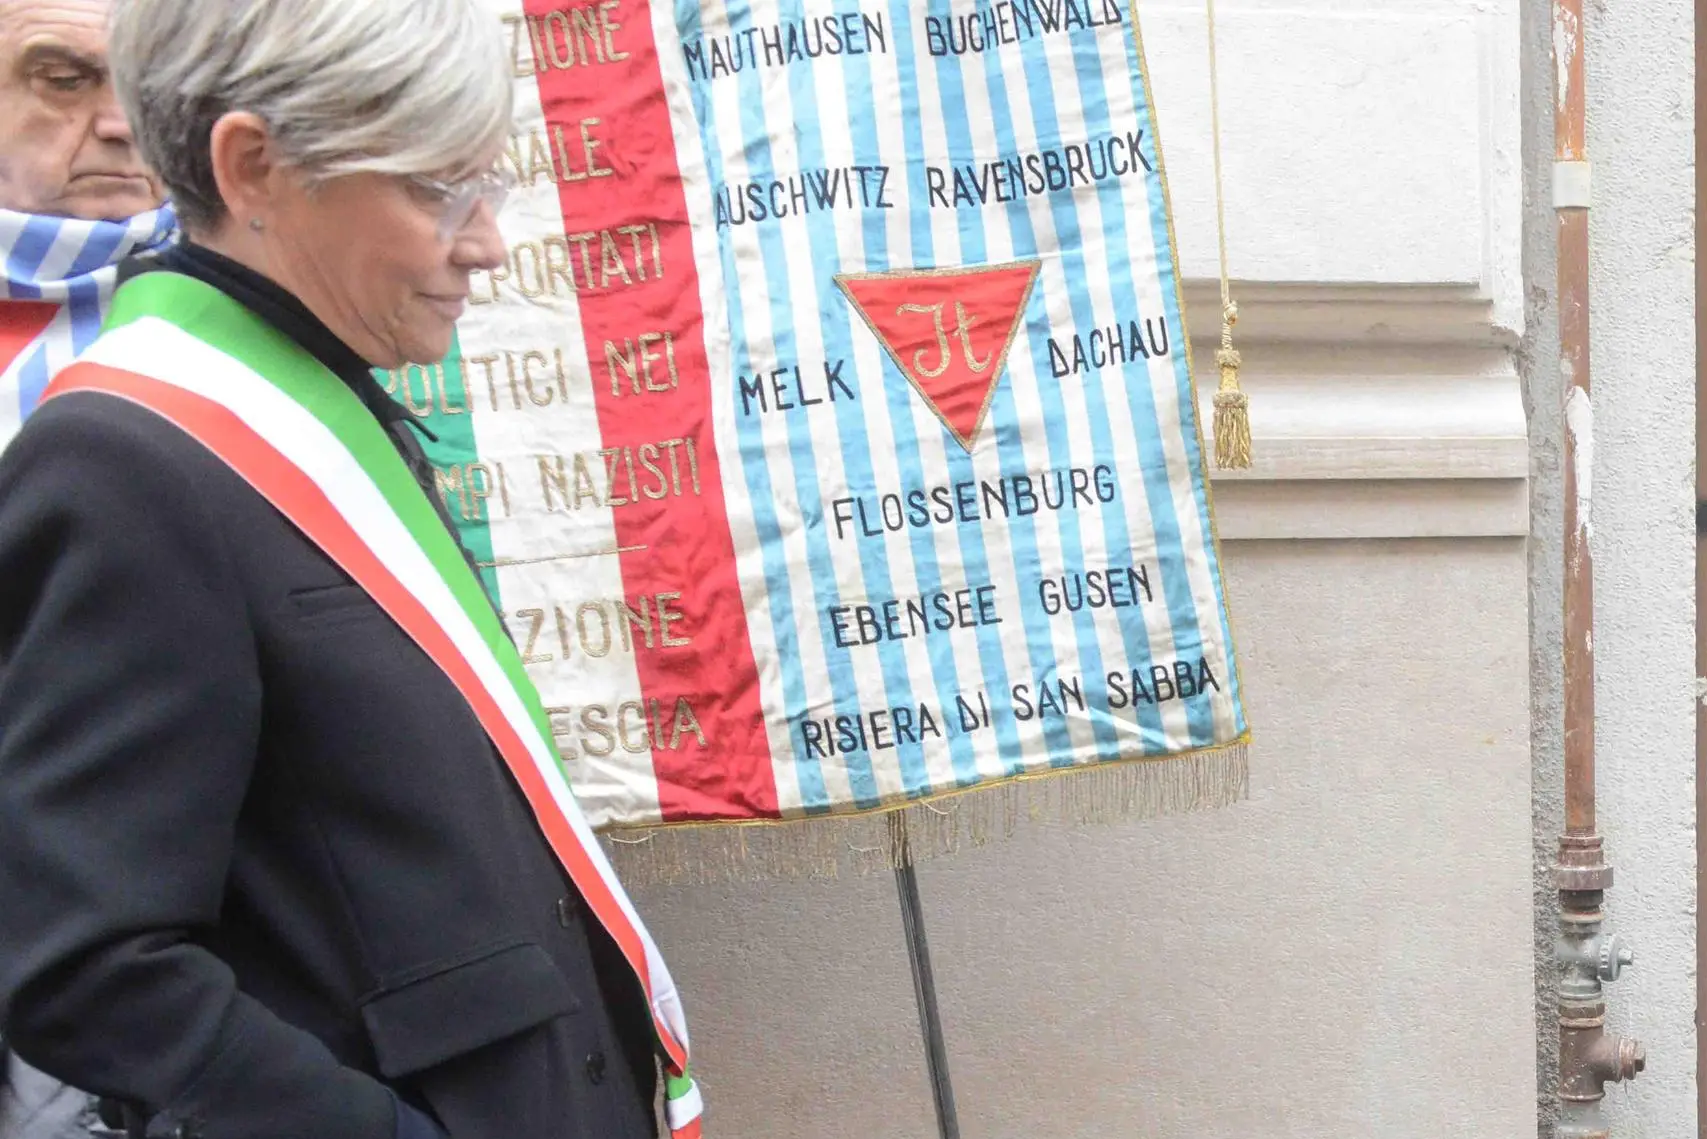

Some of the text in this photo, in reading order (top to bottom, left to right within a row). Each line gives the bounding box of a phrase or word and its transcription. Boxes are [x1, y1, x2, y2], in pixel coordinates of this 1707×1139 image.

[684, 0, 1122, 81] MAUTHAUSEN BUCHENWALD
[715, 130, 1152, 232] AUSCHWITZ RAVENSBRUCK
[603, 330, 679, 397] NEI
[740, 316, 1169, 416] MELK DACHAU
[534, 437, 701, 512] NAZISTI
[832, 464, 1116, 540] FLOSSENBURG
[828, 564, 1154, 649] EBENSEE GUSEN
[800, 657, 1221, 760] RISIERA DI SAN SABBA
